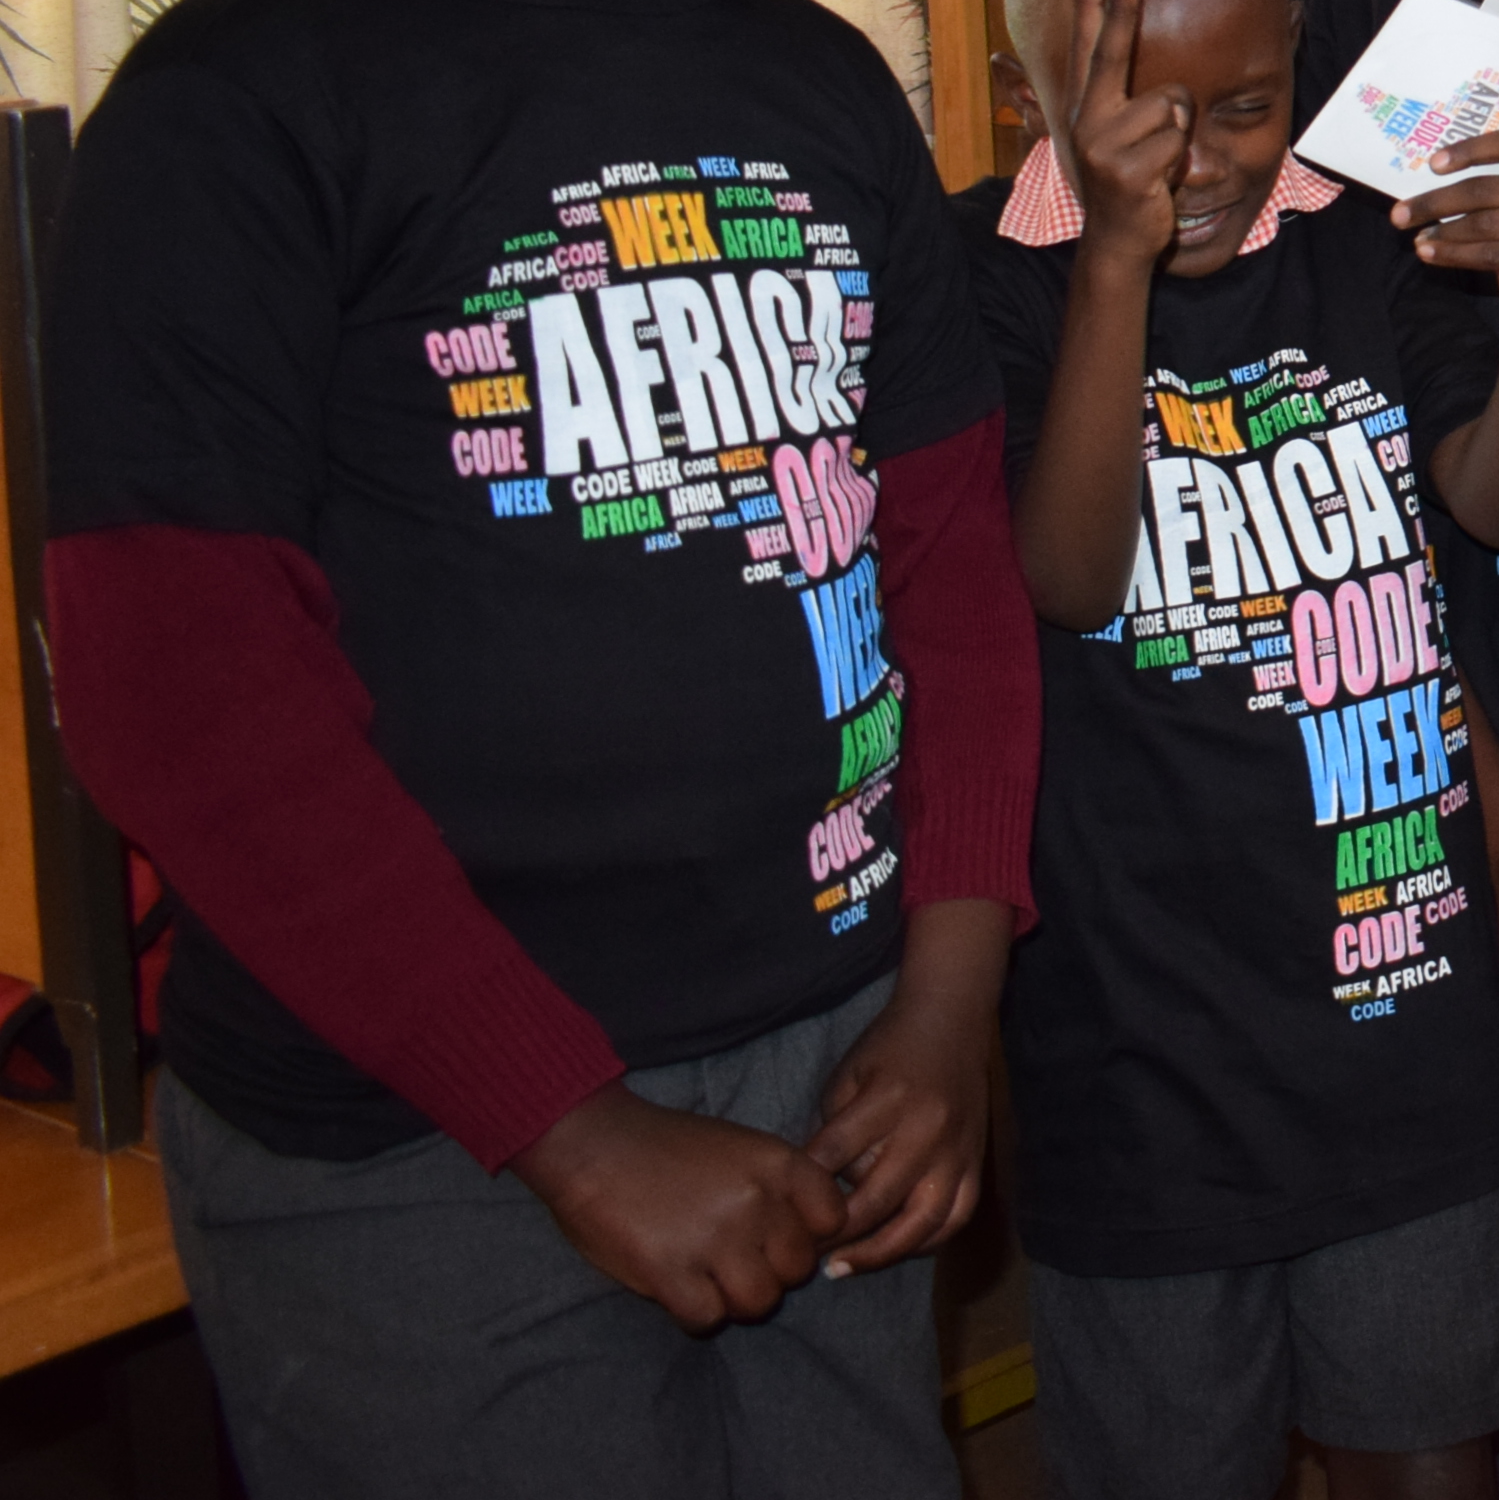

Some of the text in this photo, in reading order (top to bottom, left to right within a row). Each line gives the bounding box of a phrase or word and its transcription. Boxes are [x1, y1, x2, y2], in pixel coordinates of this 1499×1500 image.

[1382, 98, 1430, 141] WEEK
[1406, 110, 1450, 152] CODE
[601, 191, 721, 271] WEEK
[721, 217, 803, 262] AFRICA
[426, 322, 516, 377] CODE
[528, 268, 856, 478] AFRICA
[450, 375, 531, 418] WEEK
[1156, 391, 1246, 456] WEEK
[452, 428, 527, 478] CODE
[1291, 570, 1439, 707] CODE
[1299, 677, 1452, 826] WEEK
[1336, 804, 1444, 891] AFRICA
[1334, 905, 1424, 976] CODE
